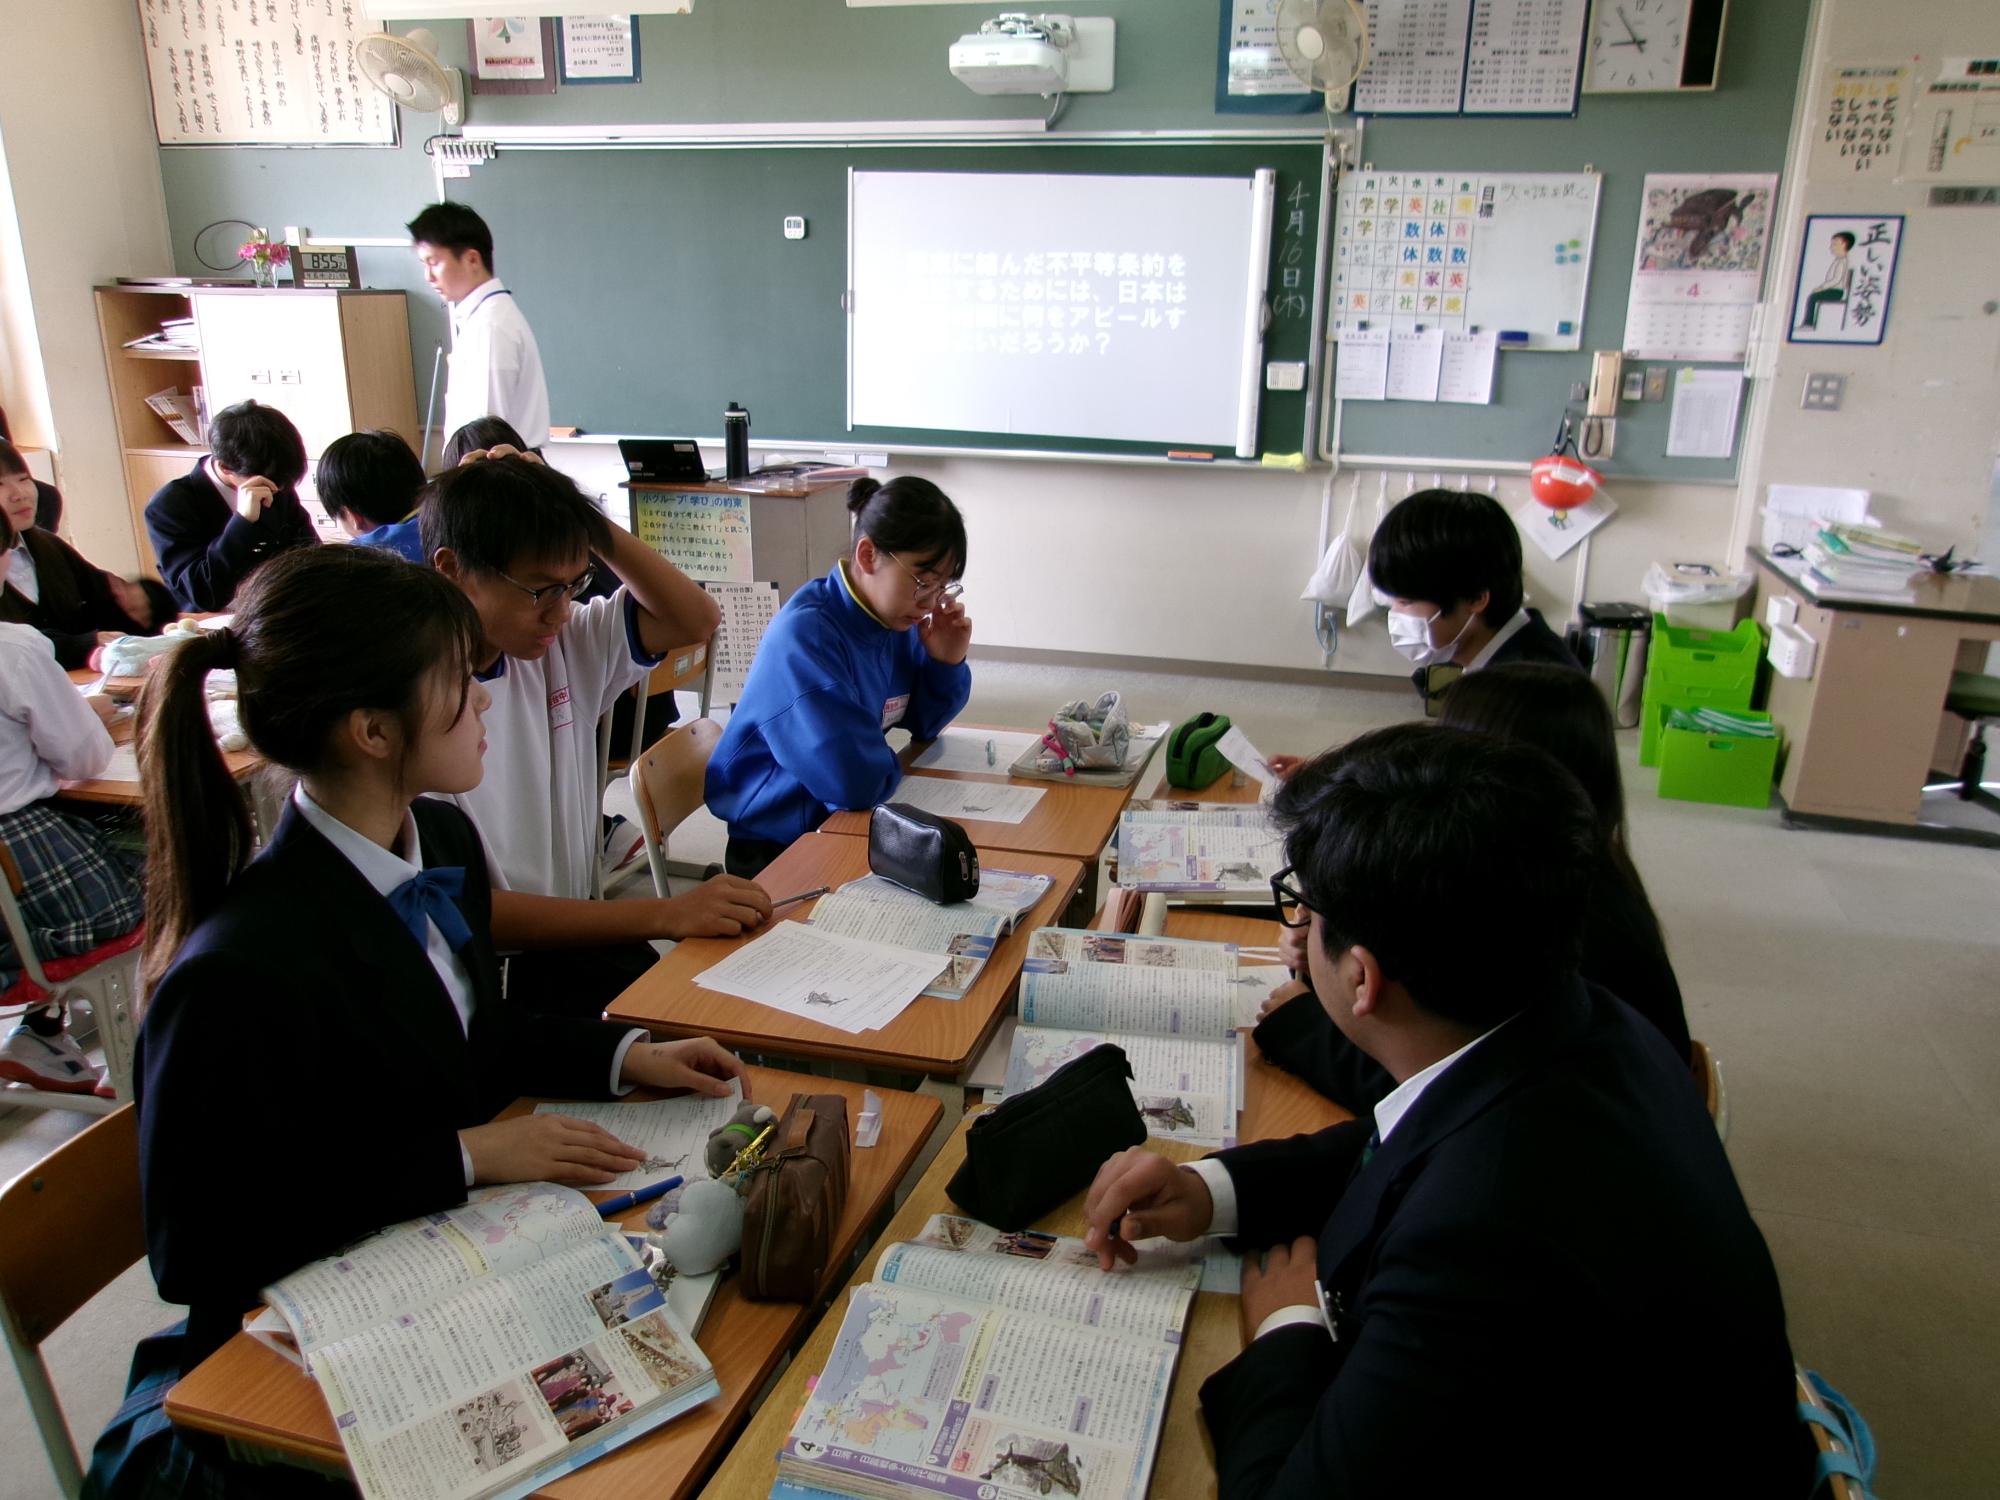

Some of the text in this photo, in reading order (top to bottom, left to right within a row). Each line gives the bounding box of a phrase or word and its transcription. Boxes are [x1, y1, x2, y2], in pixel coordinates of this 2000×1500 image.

[1389, 176, 1398, 186] 火
[1479, 186, 1495, 219] 目標
[1404, 222, 1420, 238] 数
[1430, 221, 1444, 238] 体
[1403, 246, 1418, 263] 体
[1427, 246, 1443, 263] 数
[1451, 247, 1466, 264] 数
[905, 251, 1187, 278] に結んだ不平等条約を
[1851, 222, 1892, 327] 正しい姿勢
[1687, 283, 1700, 298] 4
[800, 1441, 816, 1452] 4
